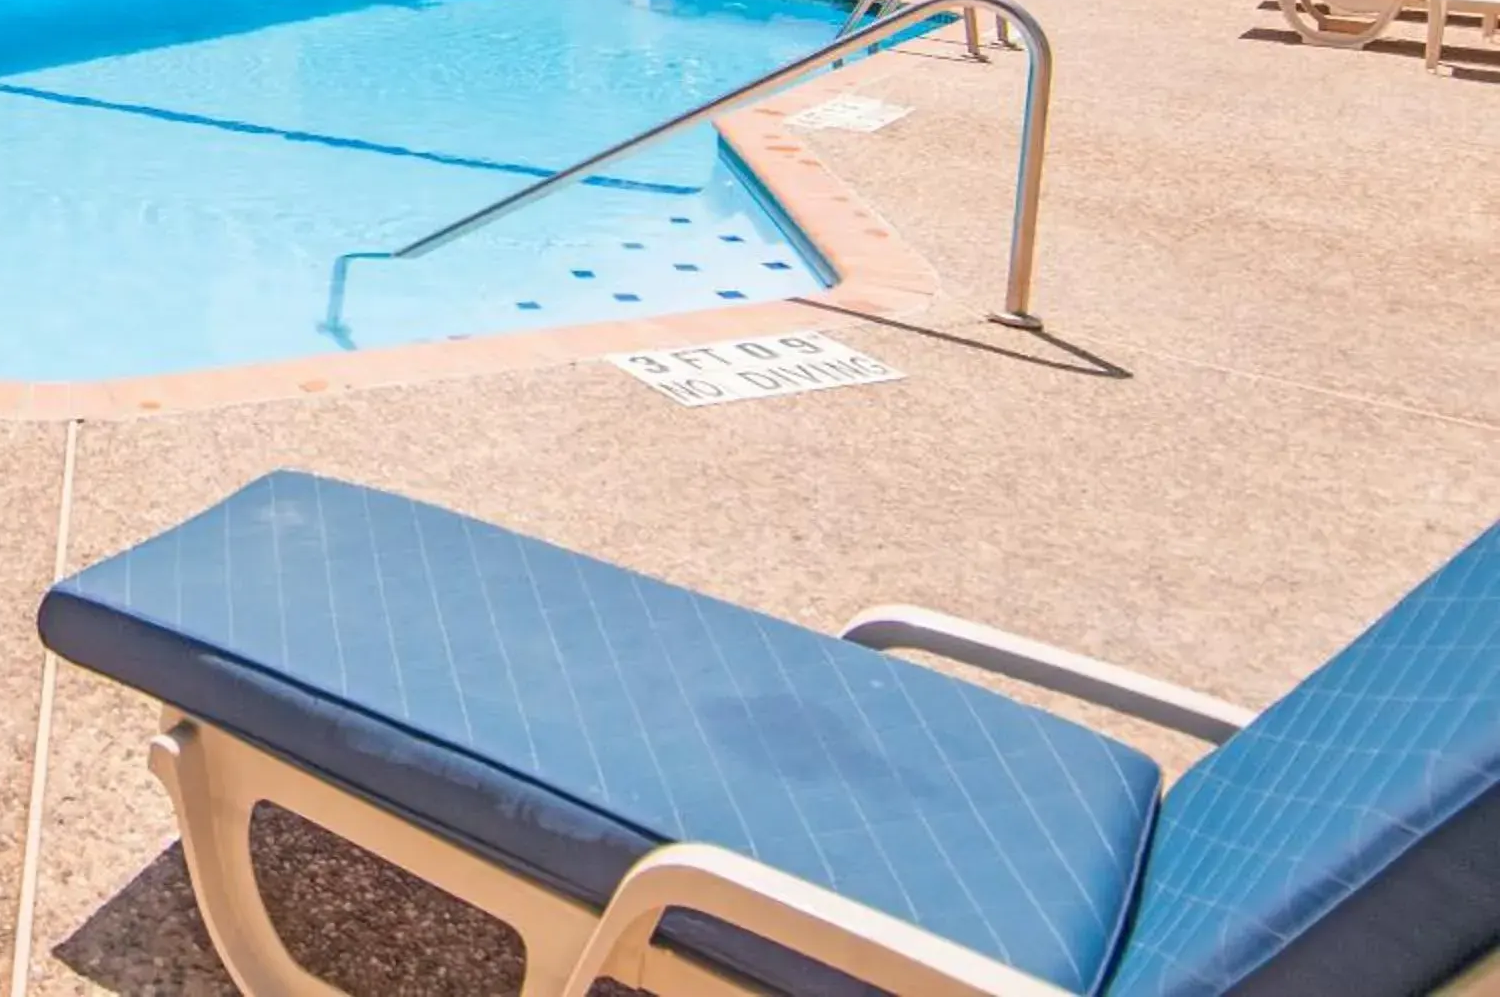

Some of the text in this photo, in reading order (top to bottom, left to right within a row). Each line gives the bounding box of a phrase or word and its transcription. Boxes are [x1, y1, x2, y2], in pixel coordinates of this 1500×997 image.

[628, 355, 671, 375] 3
[669, 347, 732, 371] FT
[657, 355, 890, 403] NO DIVING
